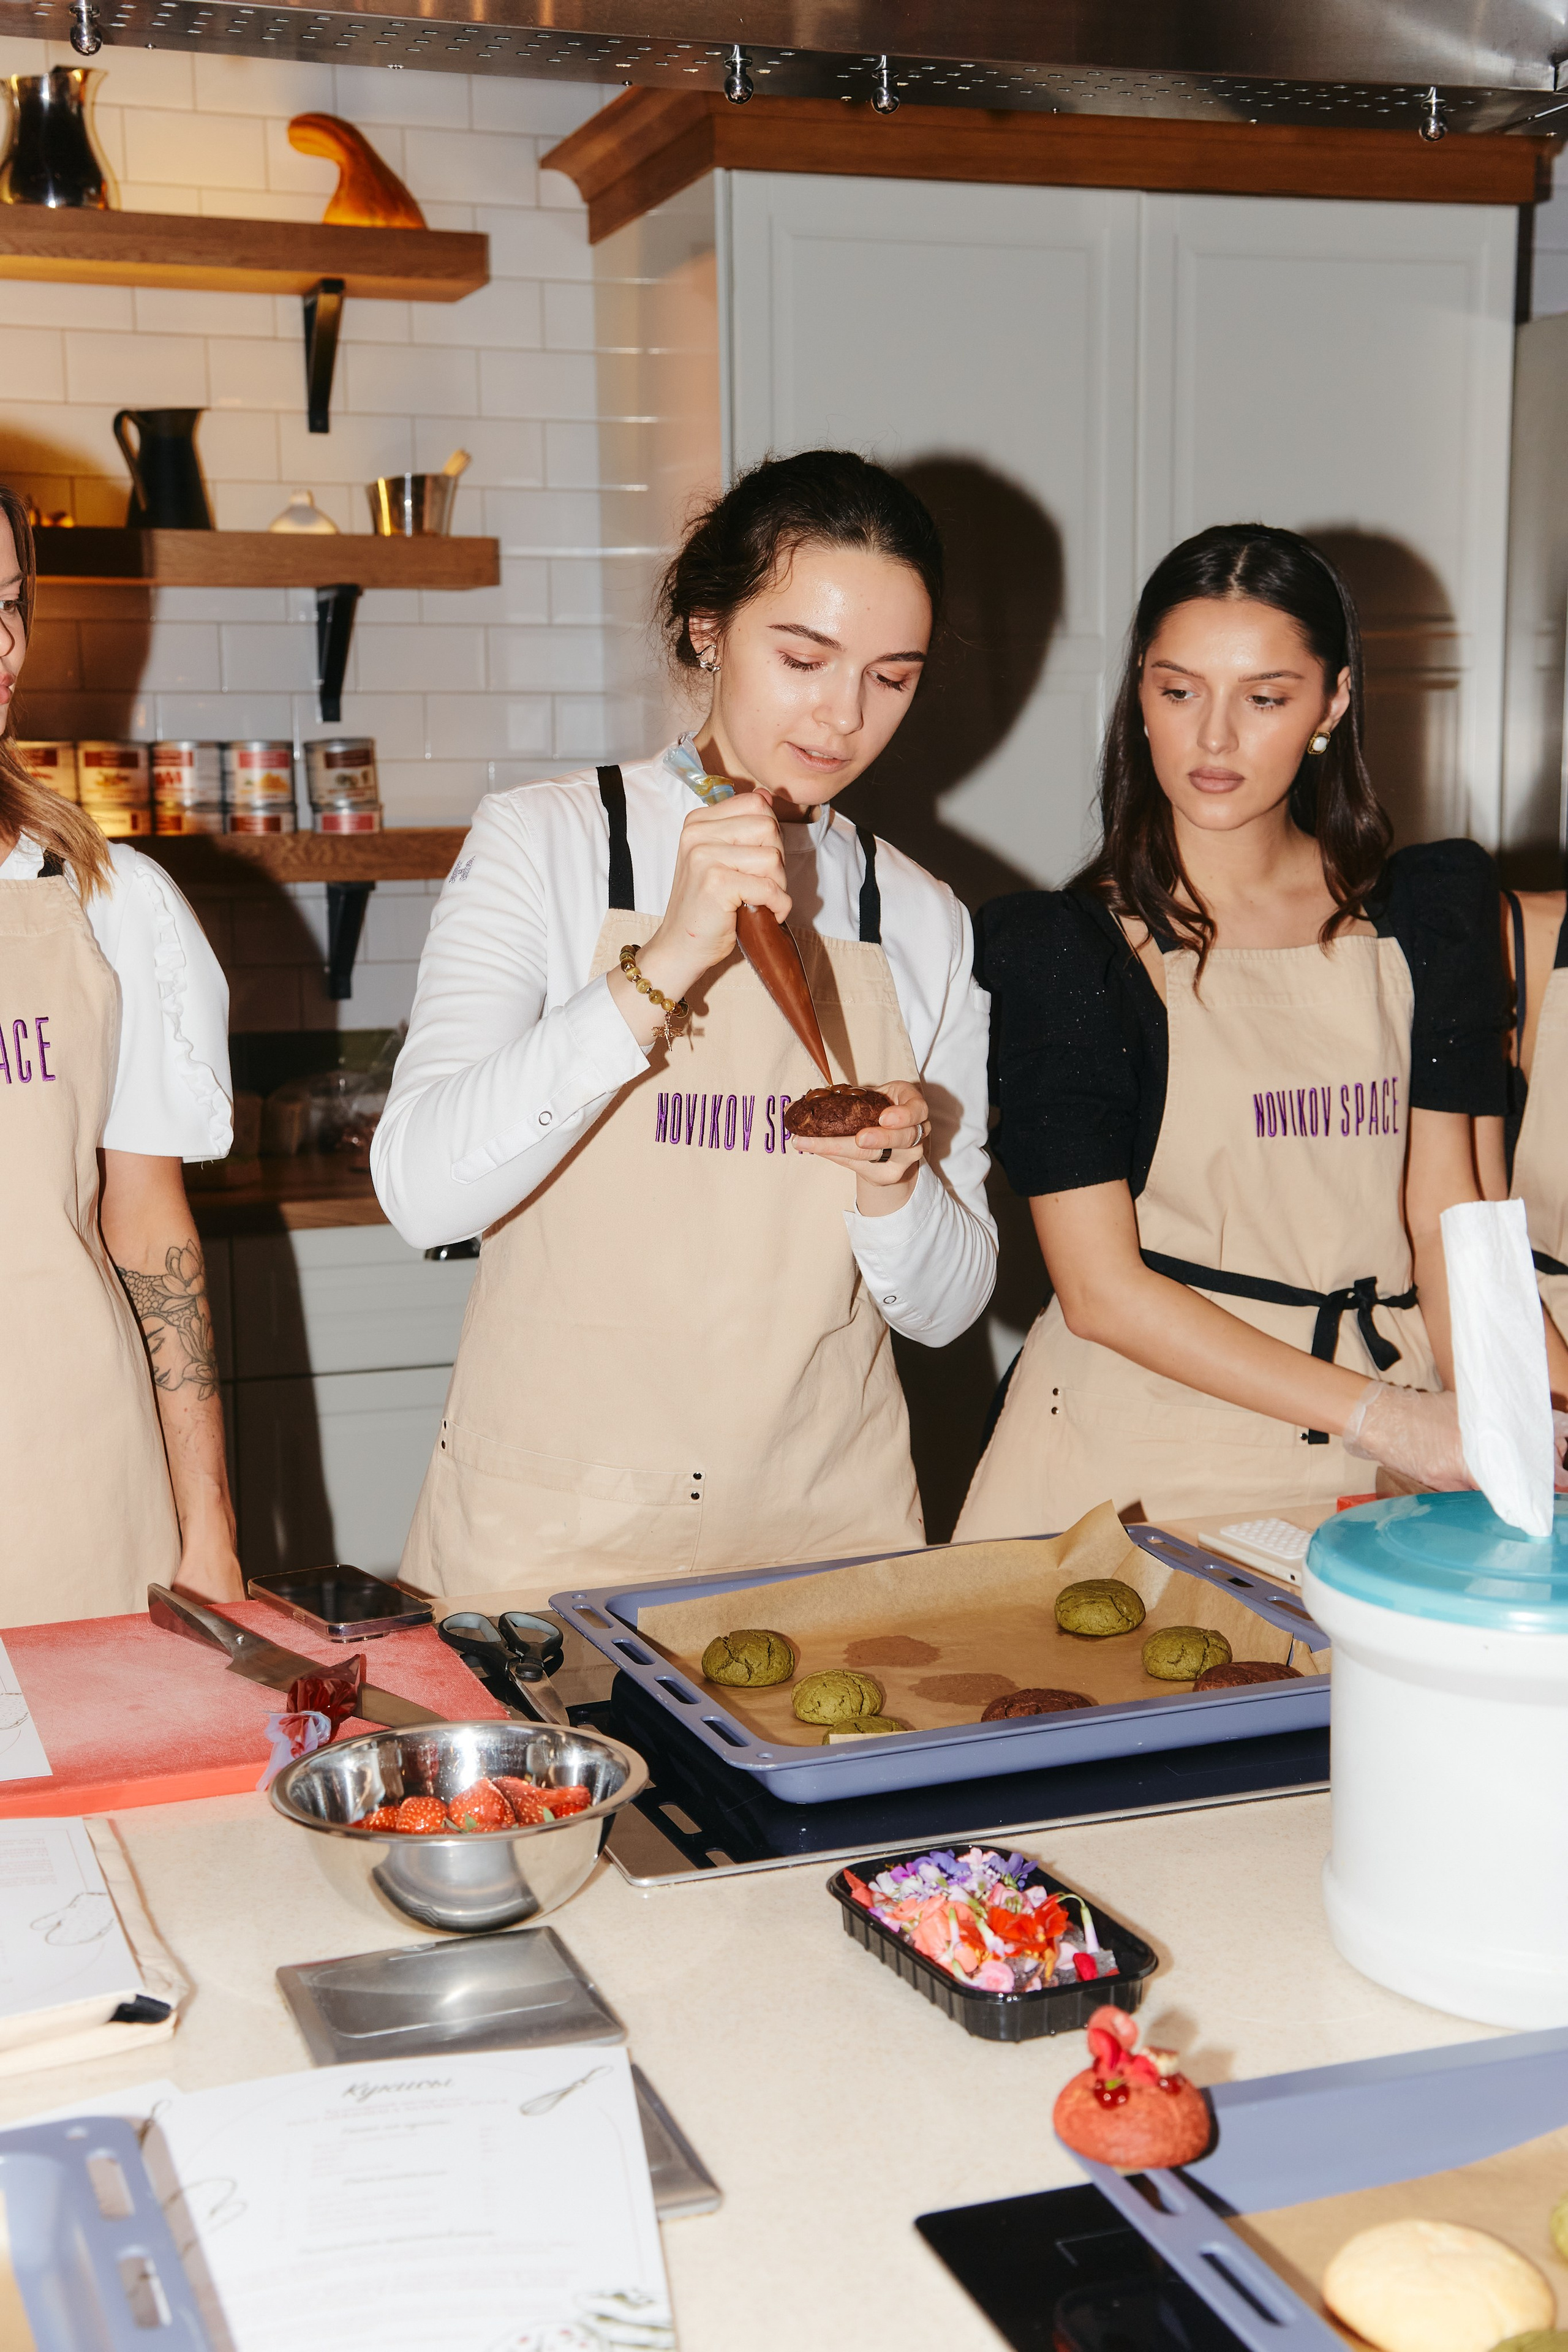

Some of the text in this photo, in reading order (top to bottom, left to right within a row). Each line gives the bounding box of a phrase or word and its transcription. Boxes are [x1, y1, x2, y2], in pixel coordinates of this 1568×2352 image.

[655, 1092, 814, 1155] NOVIKOV SP
[1253, 1076, 1399, 1137] NOVIKOV SPACE
